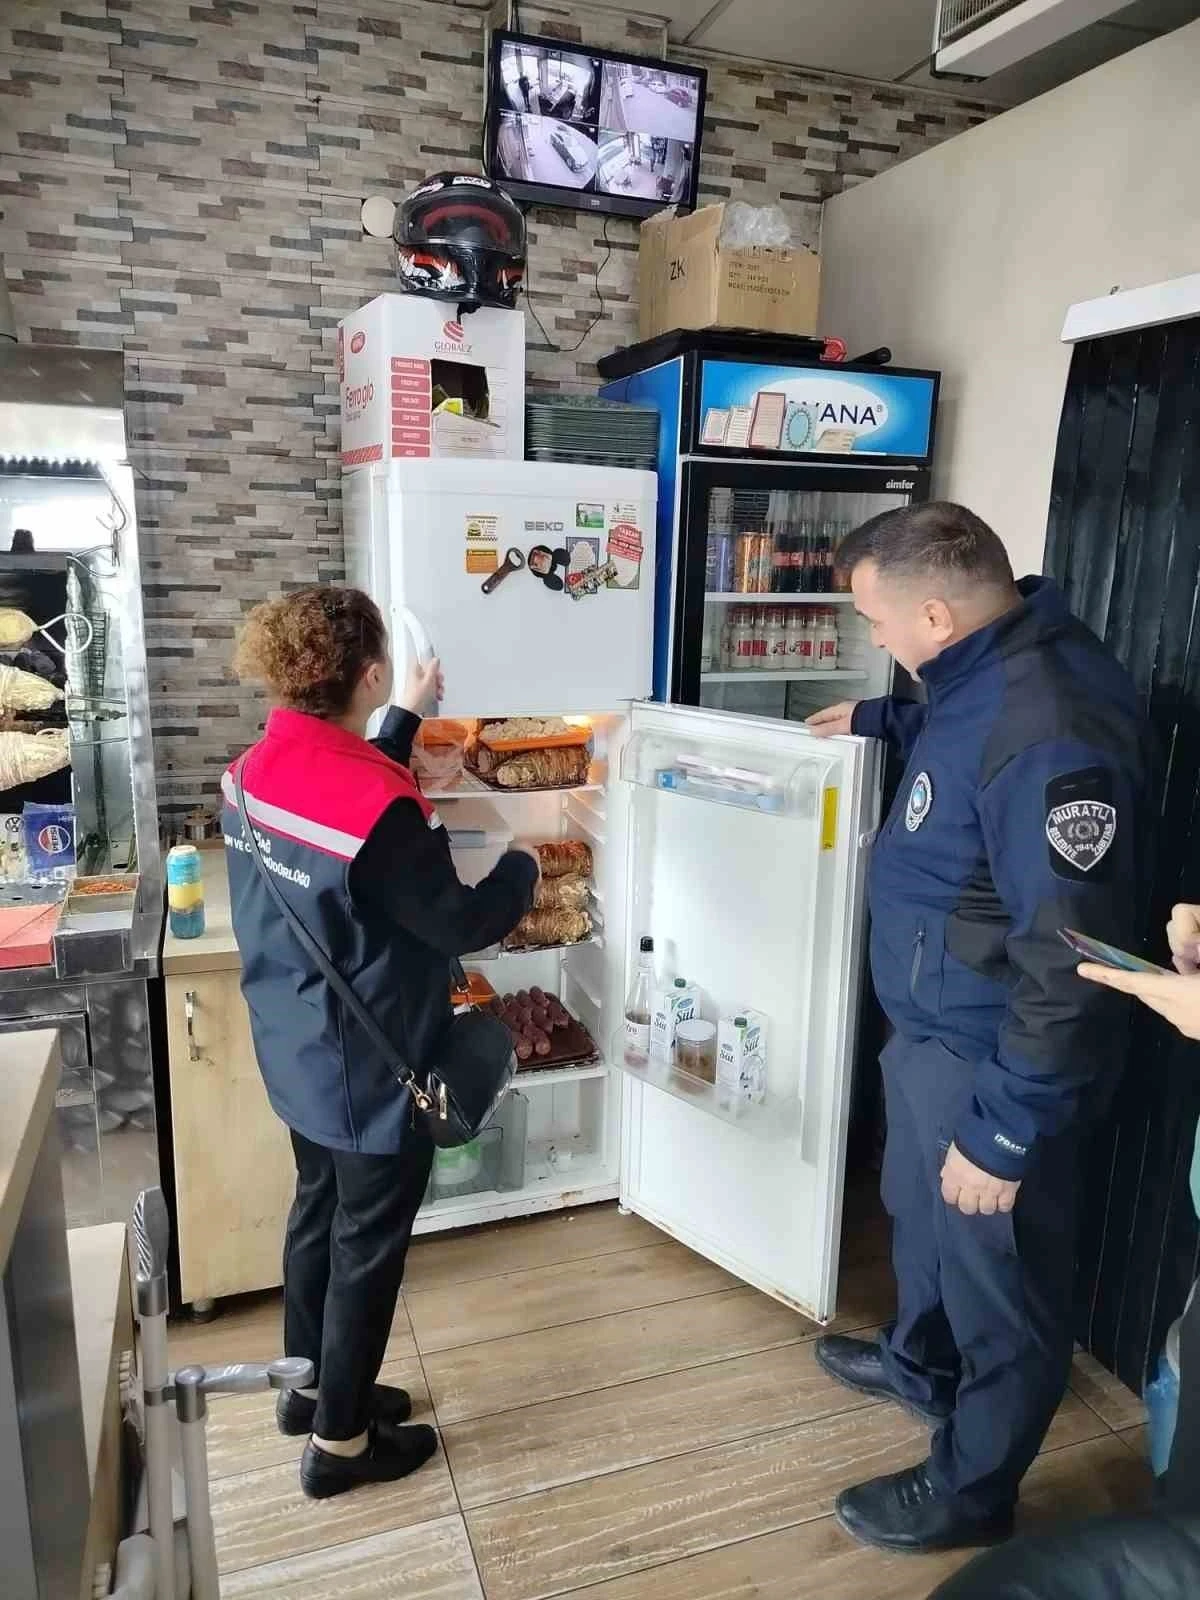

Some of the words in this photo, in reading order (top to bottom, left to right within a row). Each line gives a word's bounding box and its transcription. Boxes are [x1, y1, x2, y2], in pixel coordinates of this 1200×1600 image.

[670, 258, 685, 281] ZK
[885, 480, 914, 489] simfer
[524, 520, 564, 532] BEKO
[1053, 804, 1110, 824] MURATLI
